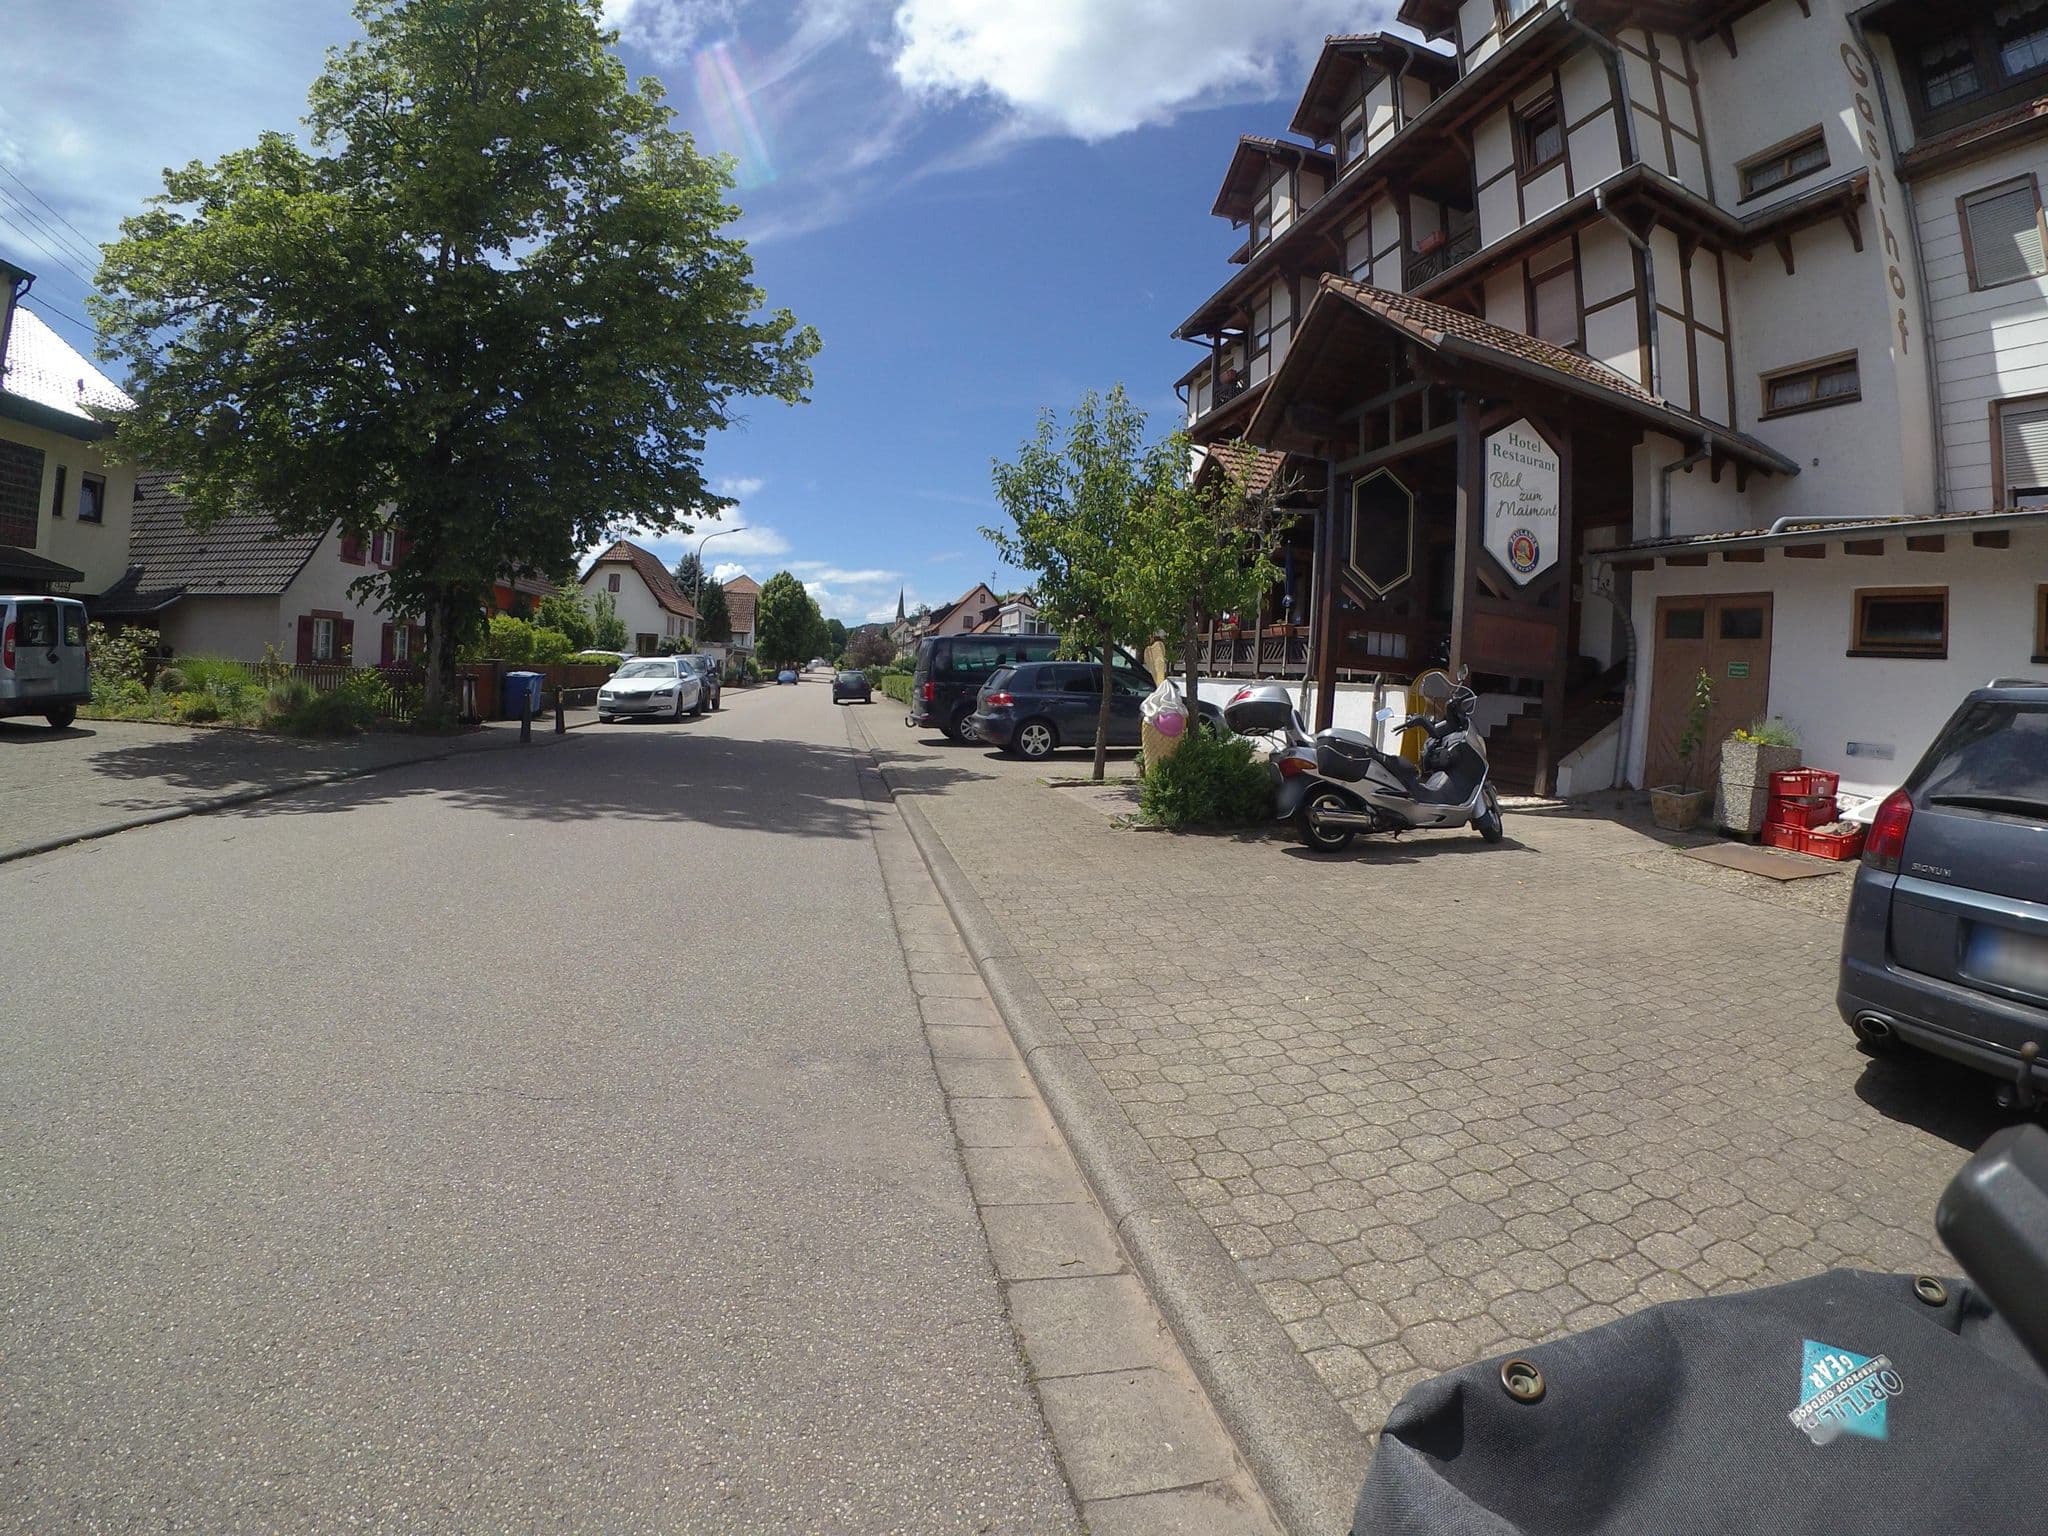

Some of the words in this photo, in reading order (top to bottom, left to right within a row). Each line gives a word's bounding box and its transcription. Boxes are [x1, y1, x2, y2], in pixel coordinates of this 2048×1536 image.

[1840, 43, 1908, 355] Gasthof
[1509, 433, 1541, 453] Hotel
[1493, 443, 1556, 472] Restaurant
[1489, 471, 1523, 491] Blick
[1519, 490, 1543, 502] zum
[1496, 501, 1558, 518] Maimont
[1911, 862, 1951, 877] SIGNUM
[1808, 1354, 1854, 1389] GEAR
[1793, 1388, 1835, 1422] OUTDOO
